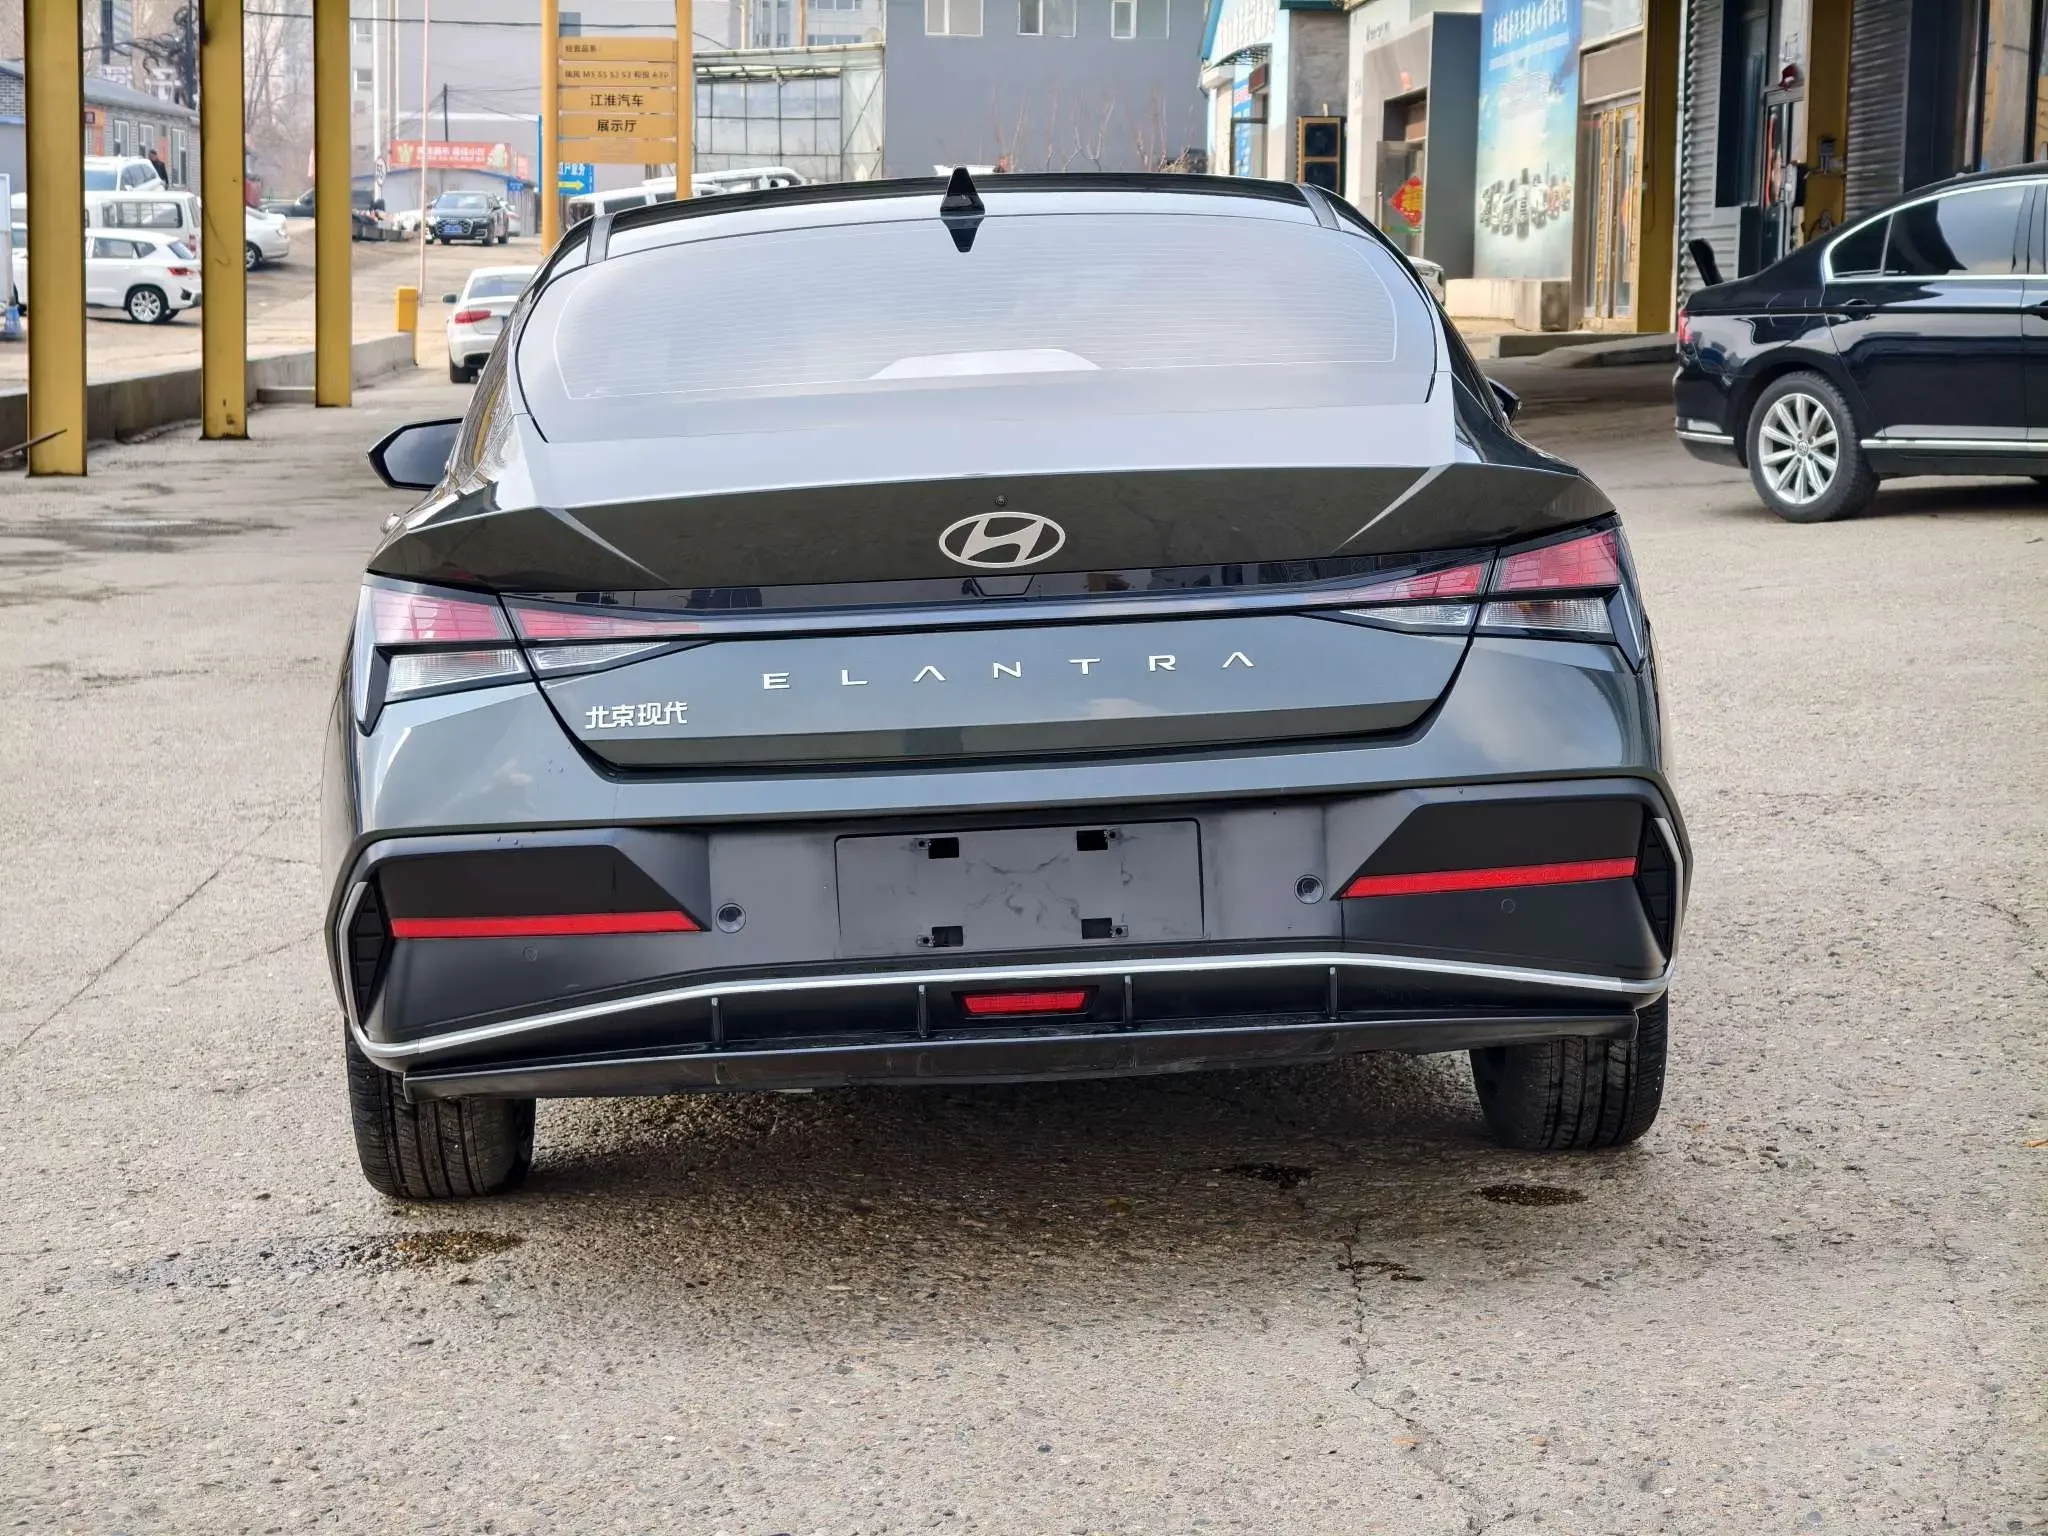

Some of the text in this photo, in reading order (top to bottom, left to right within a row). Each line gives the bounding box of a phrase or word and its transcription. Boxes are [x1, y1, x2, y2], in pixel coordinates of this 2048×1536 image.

[590, 93, 644, 107] 江淮汽车
[597, 119, 637, 132] 展示厅
[762, 651, 1255, 690] ELANTRA
[585, 700, 688, 729] 北京现代
